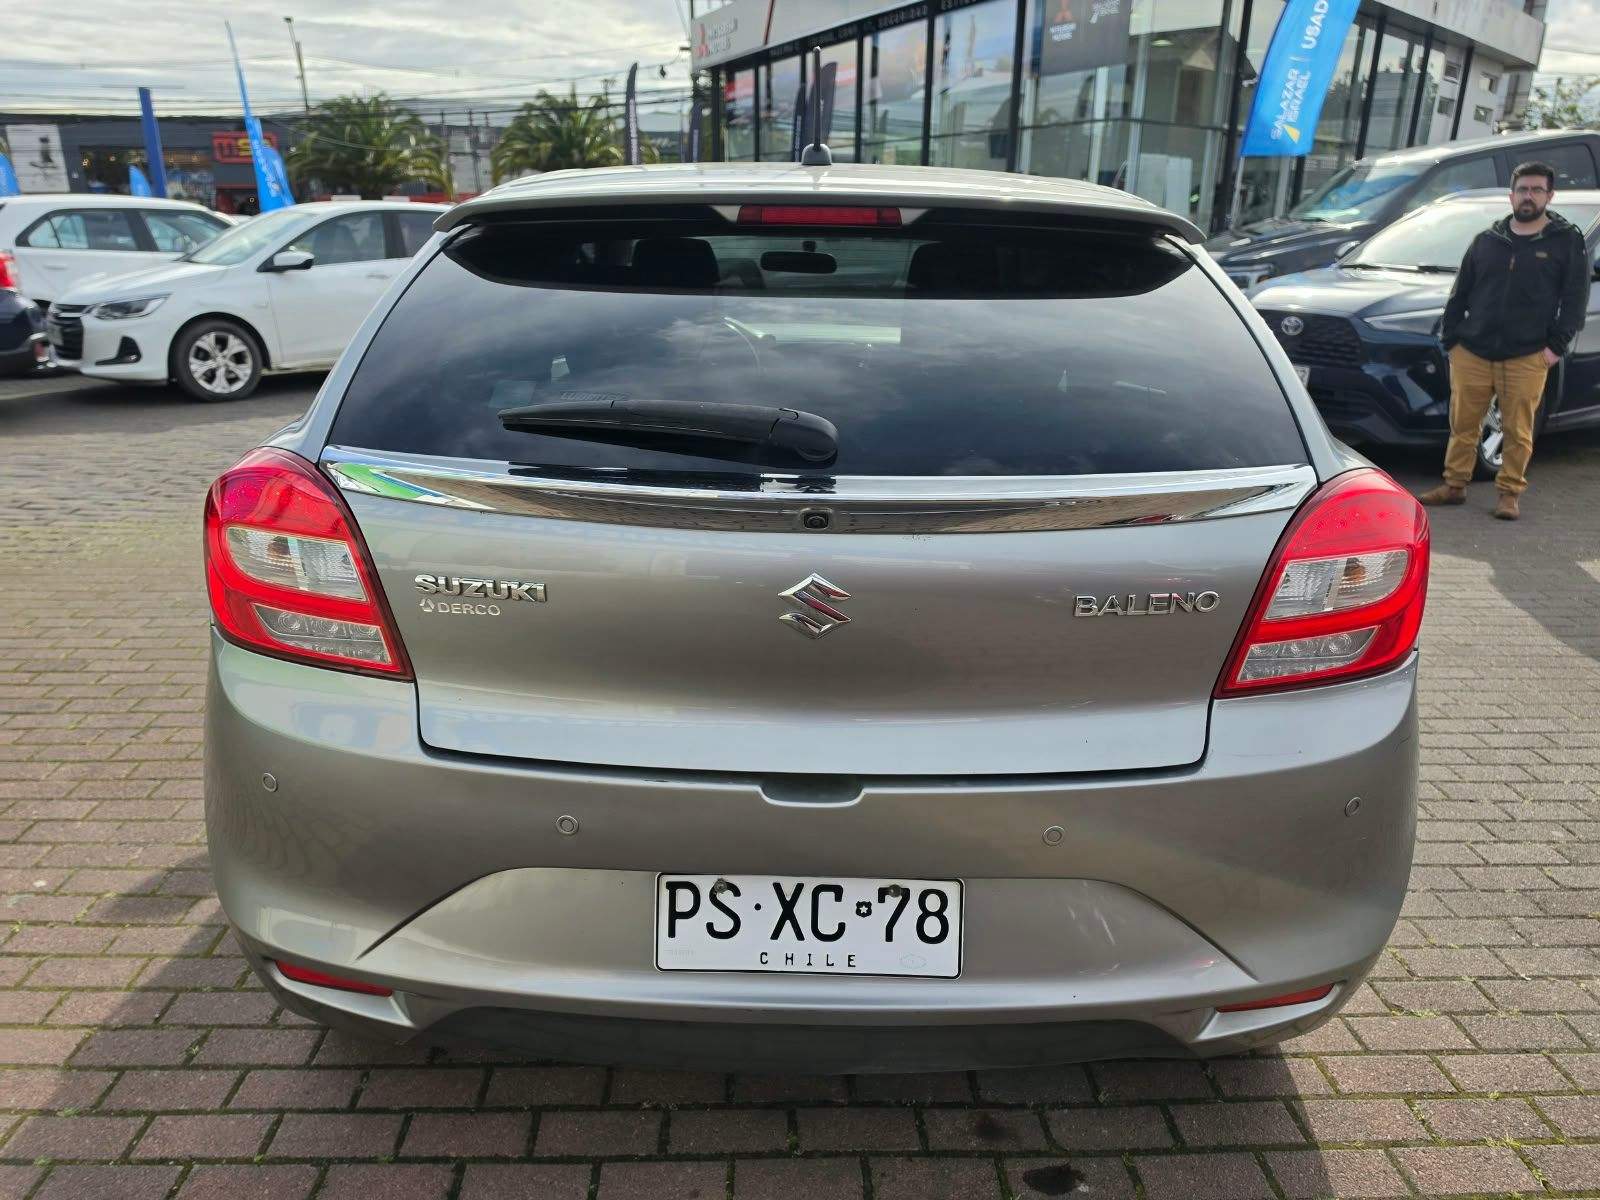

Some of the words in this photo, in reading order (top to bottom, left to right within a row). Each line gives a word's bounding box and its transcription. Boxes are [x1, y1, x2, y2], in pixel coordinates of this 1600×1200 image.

[414, 574, 547, 602] SUZUKI
[437, 602, 501, 616] DERCO
[1073, 591, 1221, 617] BALENO
[759, 951, 857, 968] CHILE
